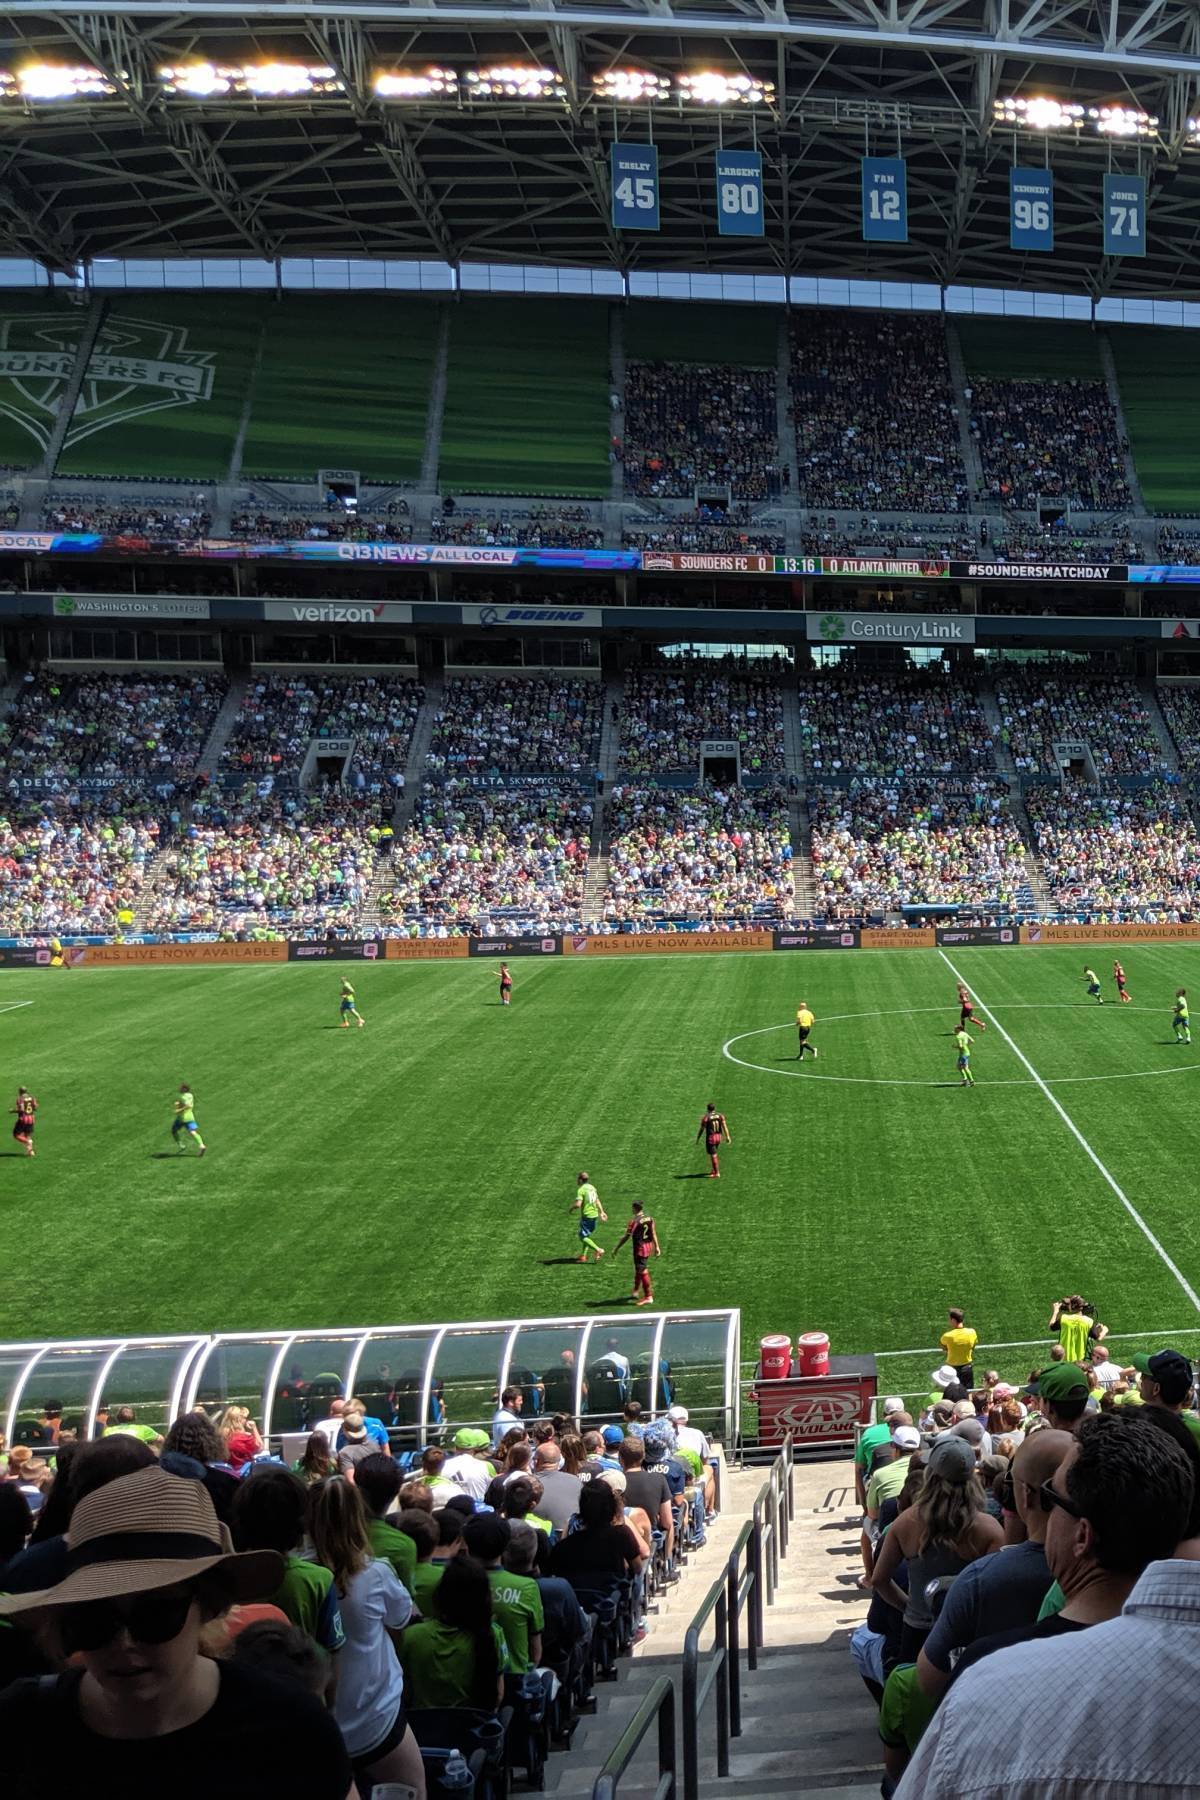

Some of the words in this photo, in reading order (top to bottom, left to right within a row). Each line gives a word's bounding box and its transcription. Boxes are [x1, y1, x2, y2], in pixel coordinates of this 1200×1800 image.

[618, 162, 651, 172] EASLEY
[718, 167, 760, 178] LARGENT
[874, 174, 895, 183] FAN
[615, 178, 655, 209] 45
[1014, 185, 1050, 195] KENNEDY
[1111, 191, 1138, 201] JONES
[722, 183, 759, 214] 80
[869, 191, 901, 221] 12
[1014, 200, 1049, 231] 96
[1110, 206, 1140, 236] 71
[13, 355, 147, 368] SEATLE
[158, 371, 195, 388] FC
[0, 536, 46, 548] OCAL
[434, 550, 461, 560] ALL
[464, 551, 510, 562] LOCAL
[680, 556, 733, 570] SOUNDERS
[735, 558, 748, 571] FC
[758, 559, 766, 571] 0
[783, 559, 815, 573] 13:16
[830, 560, 838, 573] 0
[842, 560, 884, 574] ATLANTA
[886, 561, 919, 576] UNITED
[968, 565, 1110, 579] #SOUNDERSMATCHDAY
[292, 604, 375, 622] verizon
[505, 609, 585, 621] BOEING
[851, 620, 962, 643] CenturyLink
[1058, 745, 1082, 754] 210
[23, 778, 70, 787] DELTA
[1046, 930, 1069, 939] MLS
[1073, 930, 1098, 938] LIVE
[1105, 929, 1132, 938] NOW
[1136, 927, 1198, 937] AVAILABLE
[593, 940, 617, 949] MLS
[624, 939, 652, 948] LIVE
[658, 938, 690, 947] NOW
[694, 936, 765, 946] AVAILABLE
[93, 950, 121, 960] MLS
[126, 949, 156, 959] LIVE
[163, 949, 197, 958] NOW
[202, 947, 280, 957] AVAILABLE
[643, 1224, 649, 1239] 2
